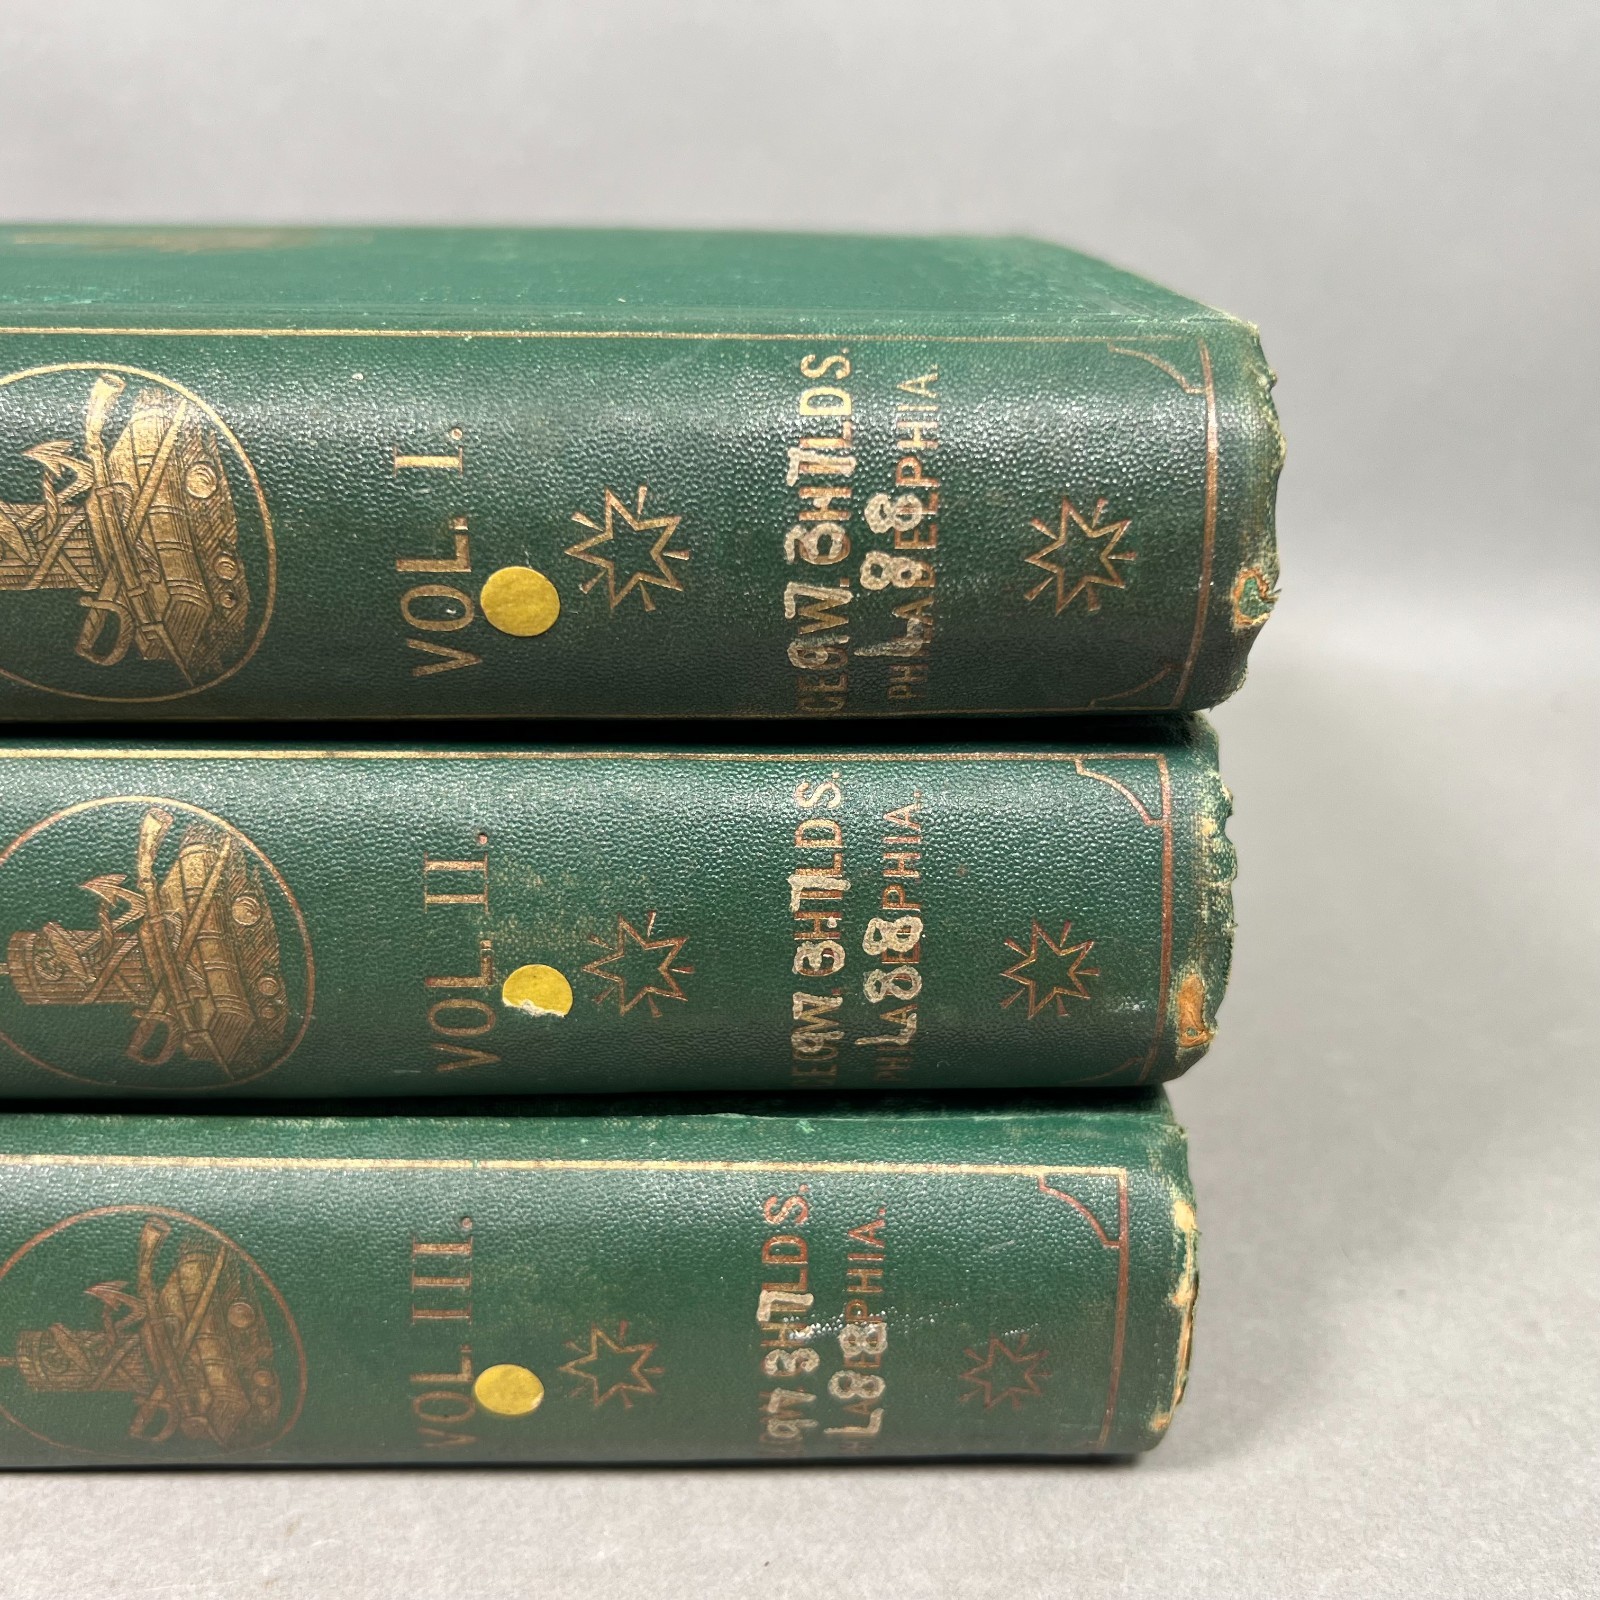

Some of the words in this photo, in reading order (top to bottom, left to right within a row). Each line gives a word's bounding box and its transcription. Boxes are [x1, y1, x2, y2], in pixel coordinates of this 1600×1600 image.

[393, 426, 464, 478] I.
[396, 516, 482, 677] VOL.
[424, 831, 489, 914] II.
[876, 790, 922, 1082] PHIAEPHIA.
[424, 939, 500, 1072] VOL.
[410, 1216, 474, 1325] III.
[410, 1344, 478, 1447] VOL.
